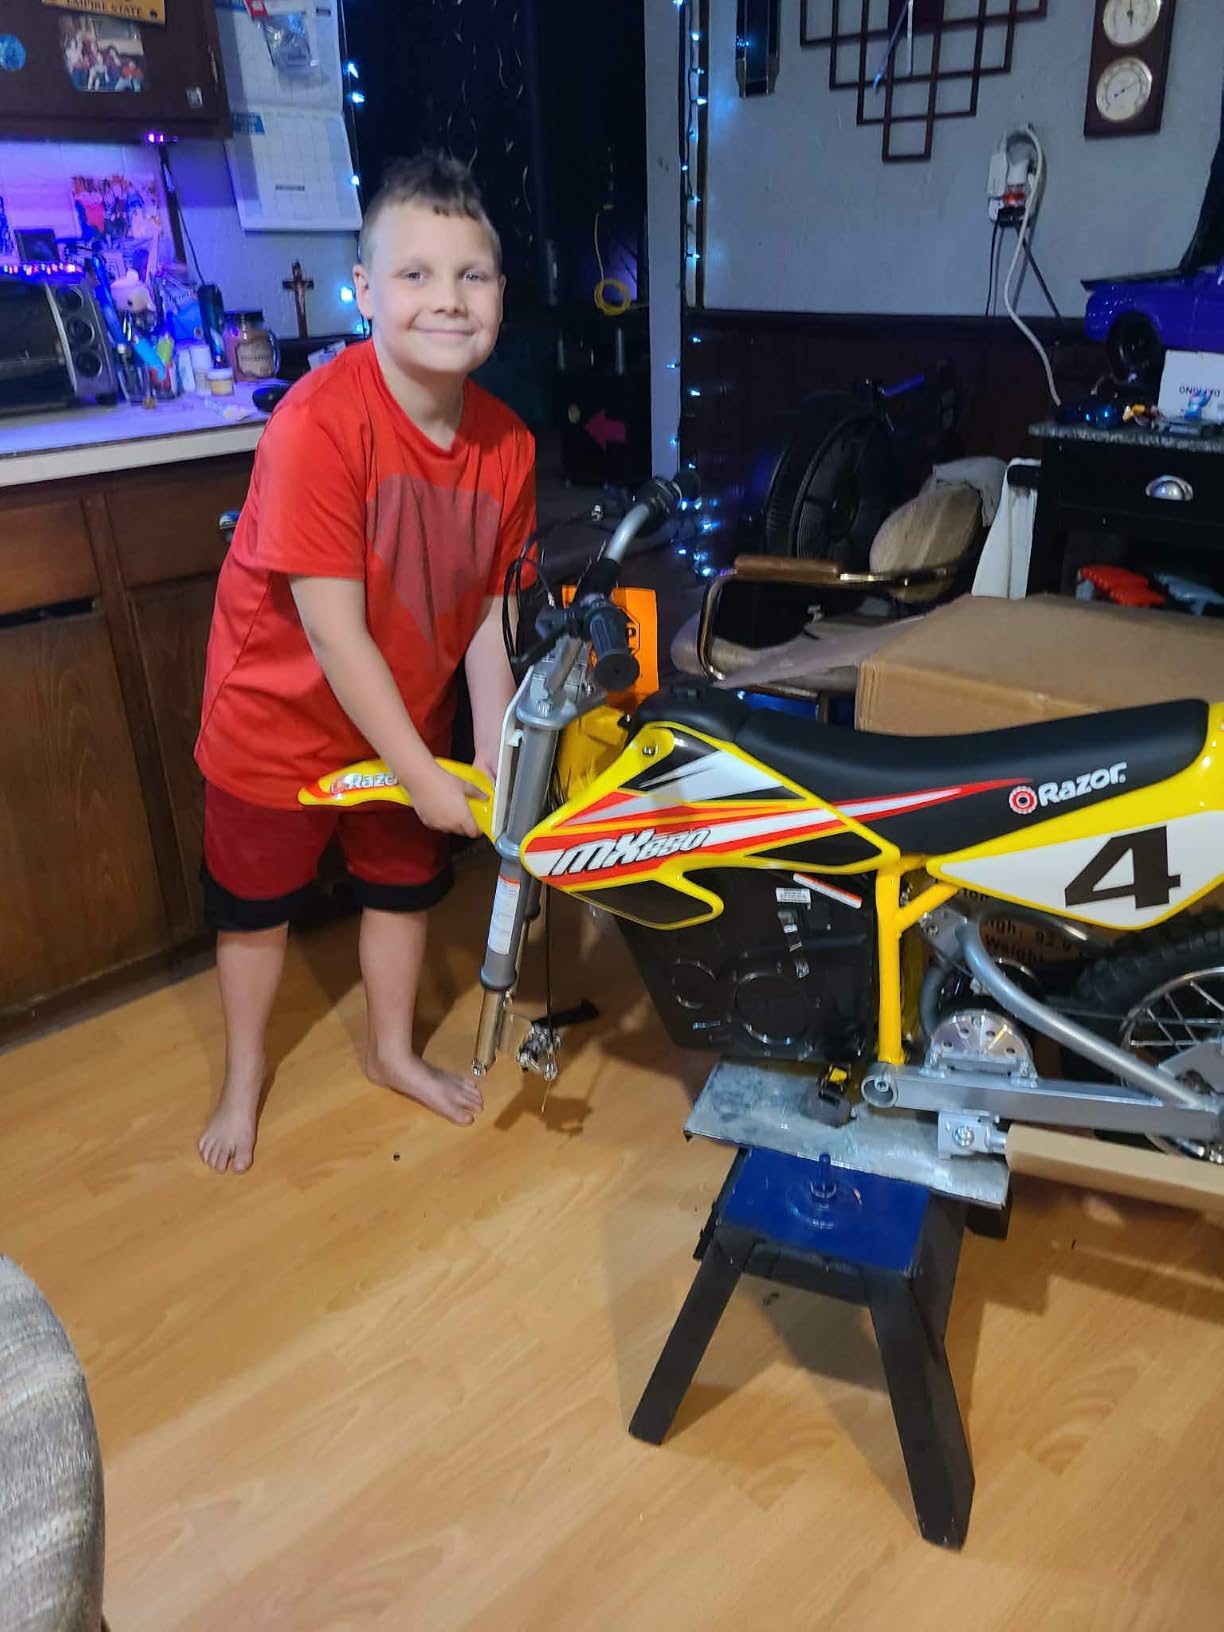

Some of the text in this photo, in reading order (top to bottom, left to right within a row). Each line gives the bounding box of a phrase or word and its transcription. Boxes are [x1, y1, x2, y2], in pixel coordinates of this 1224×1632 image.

[112, 5, 141, 17] STATE
[1038, 761, 1128, 807] Razor
[1064, 825, 1181, 909] 4
